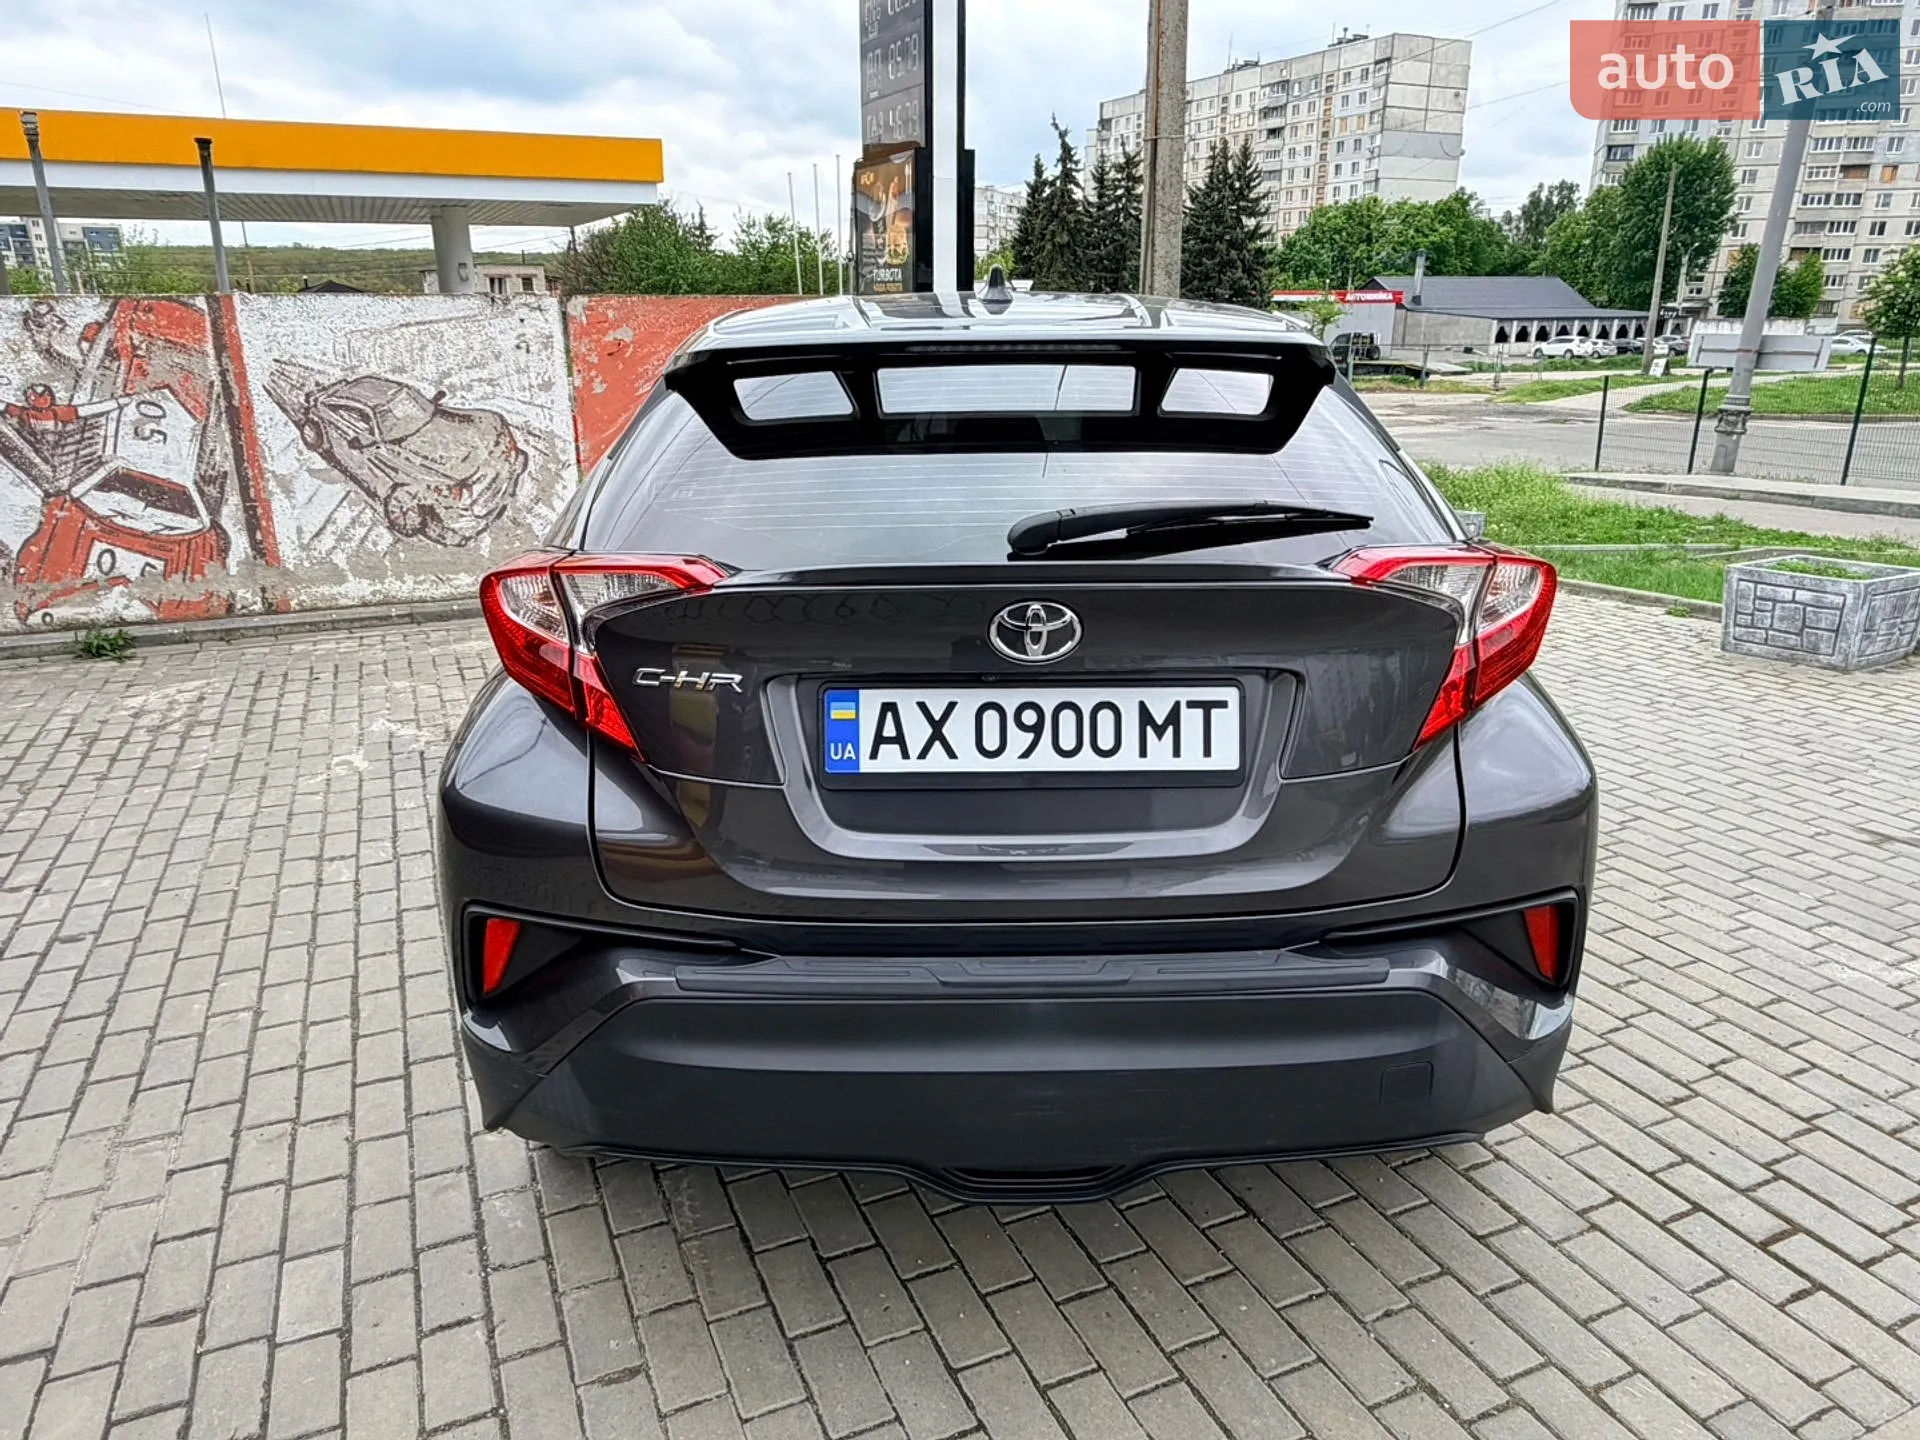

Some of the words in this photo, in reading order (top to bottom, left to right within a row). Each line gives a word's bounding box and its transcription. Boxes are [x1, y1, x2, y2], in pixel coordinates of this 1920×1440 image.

[632, 667, 743, 693] C-HR
[830, 742, 856, 760] UA
[868, 701, 959, 760] AX
[974, 700, 1123, 760] 0900
[1138, 700, 1229, 758] MT
